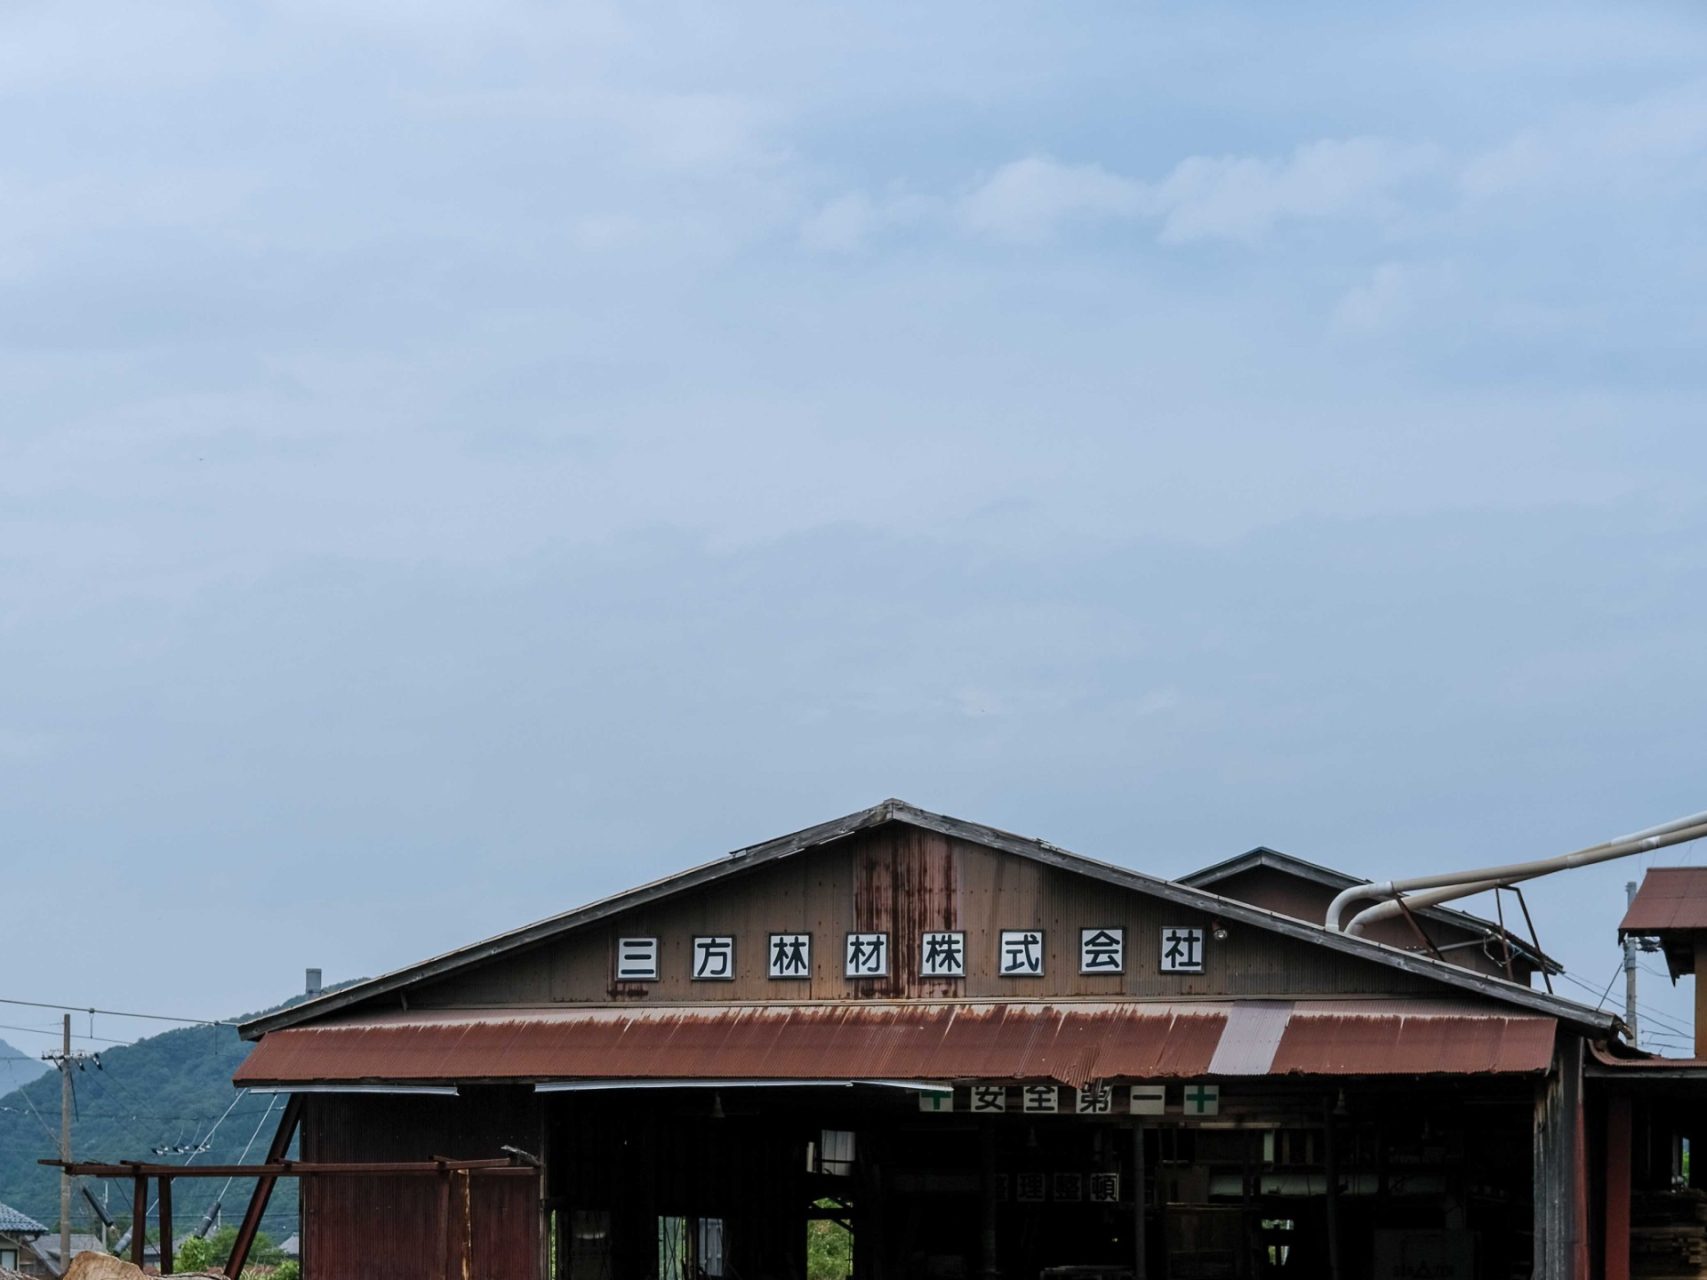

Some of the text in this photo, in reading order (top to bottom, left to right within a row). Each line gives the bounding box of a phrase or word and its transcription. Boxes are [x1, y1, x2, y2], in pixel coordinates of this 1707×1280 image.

[620, 929, 1202, 976] 三方林材株式会社
[974, 1085, 1163, 1113] 安全第一
